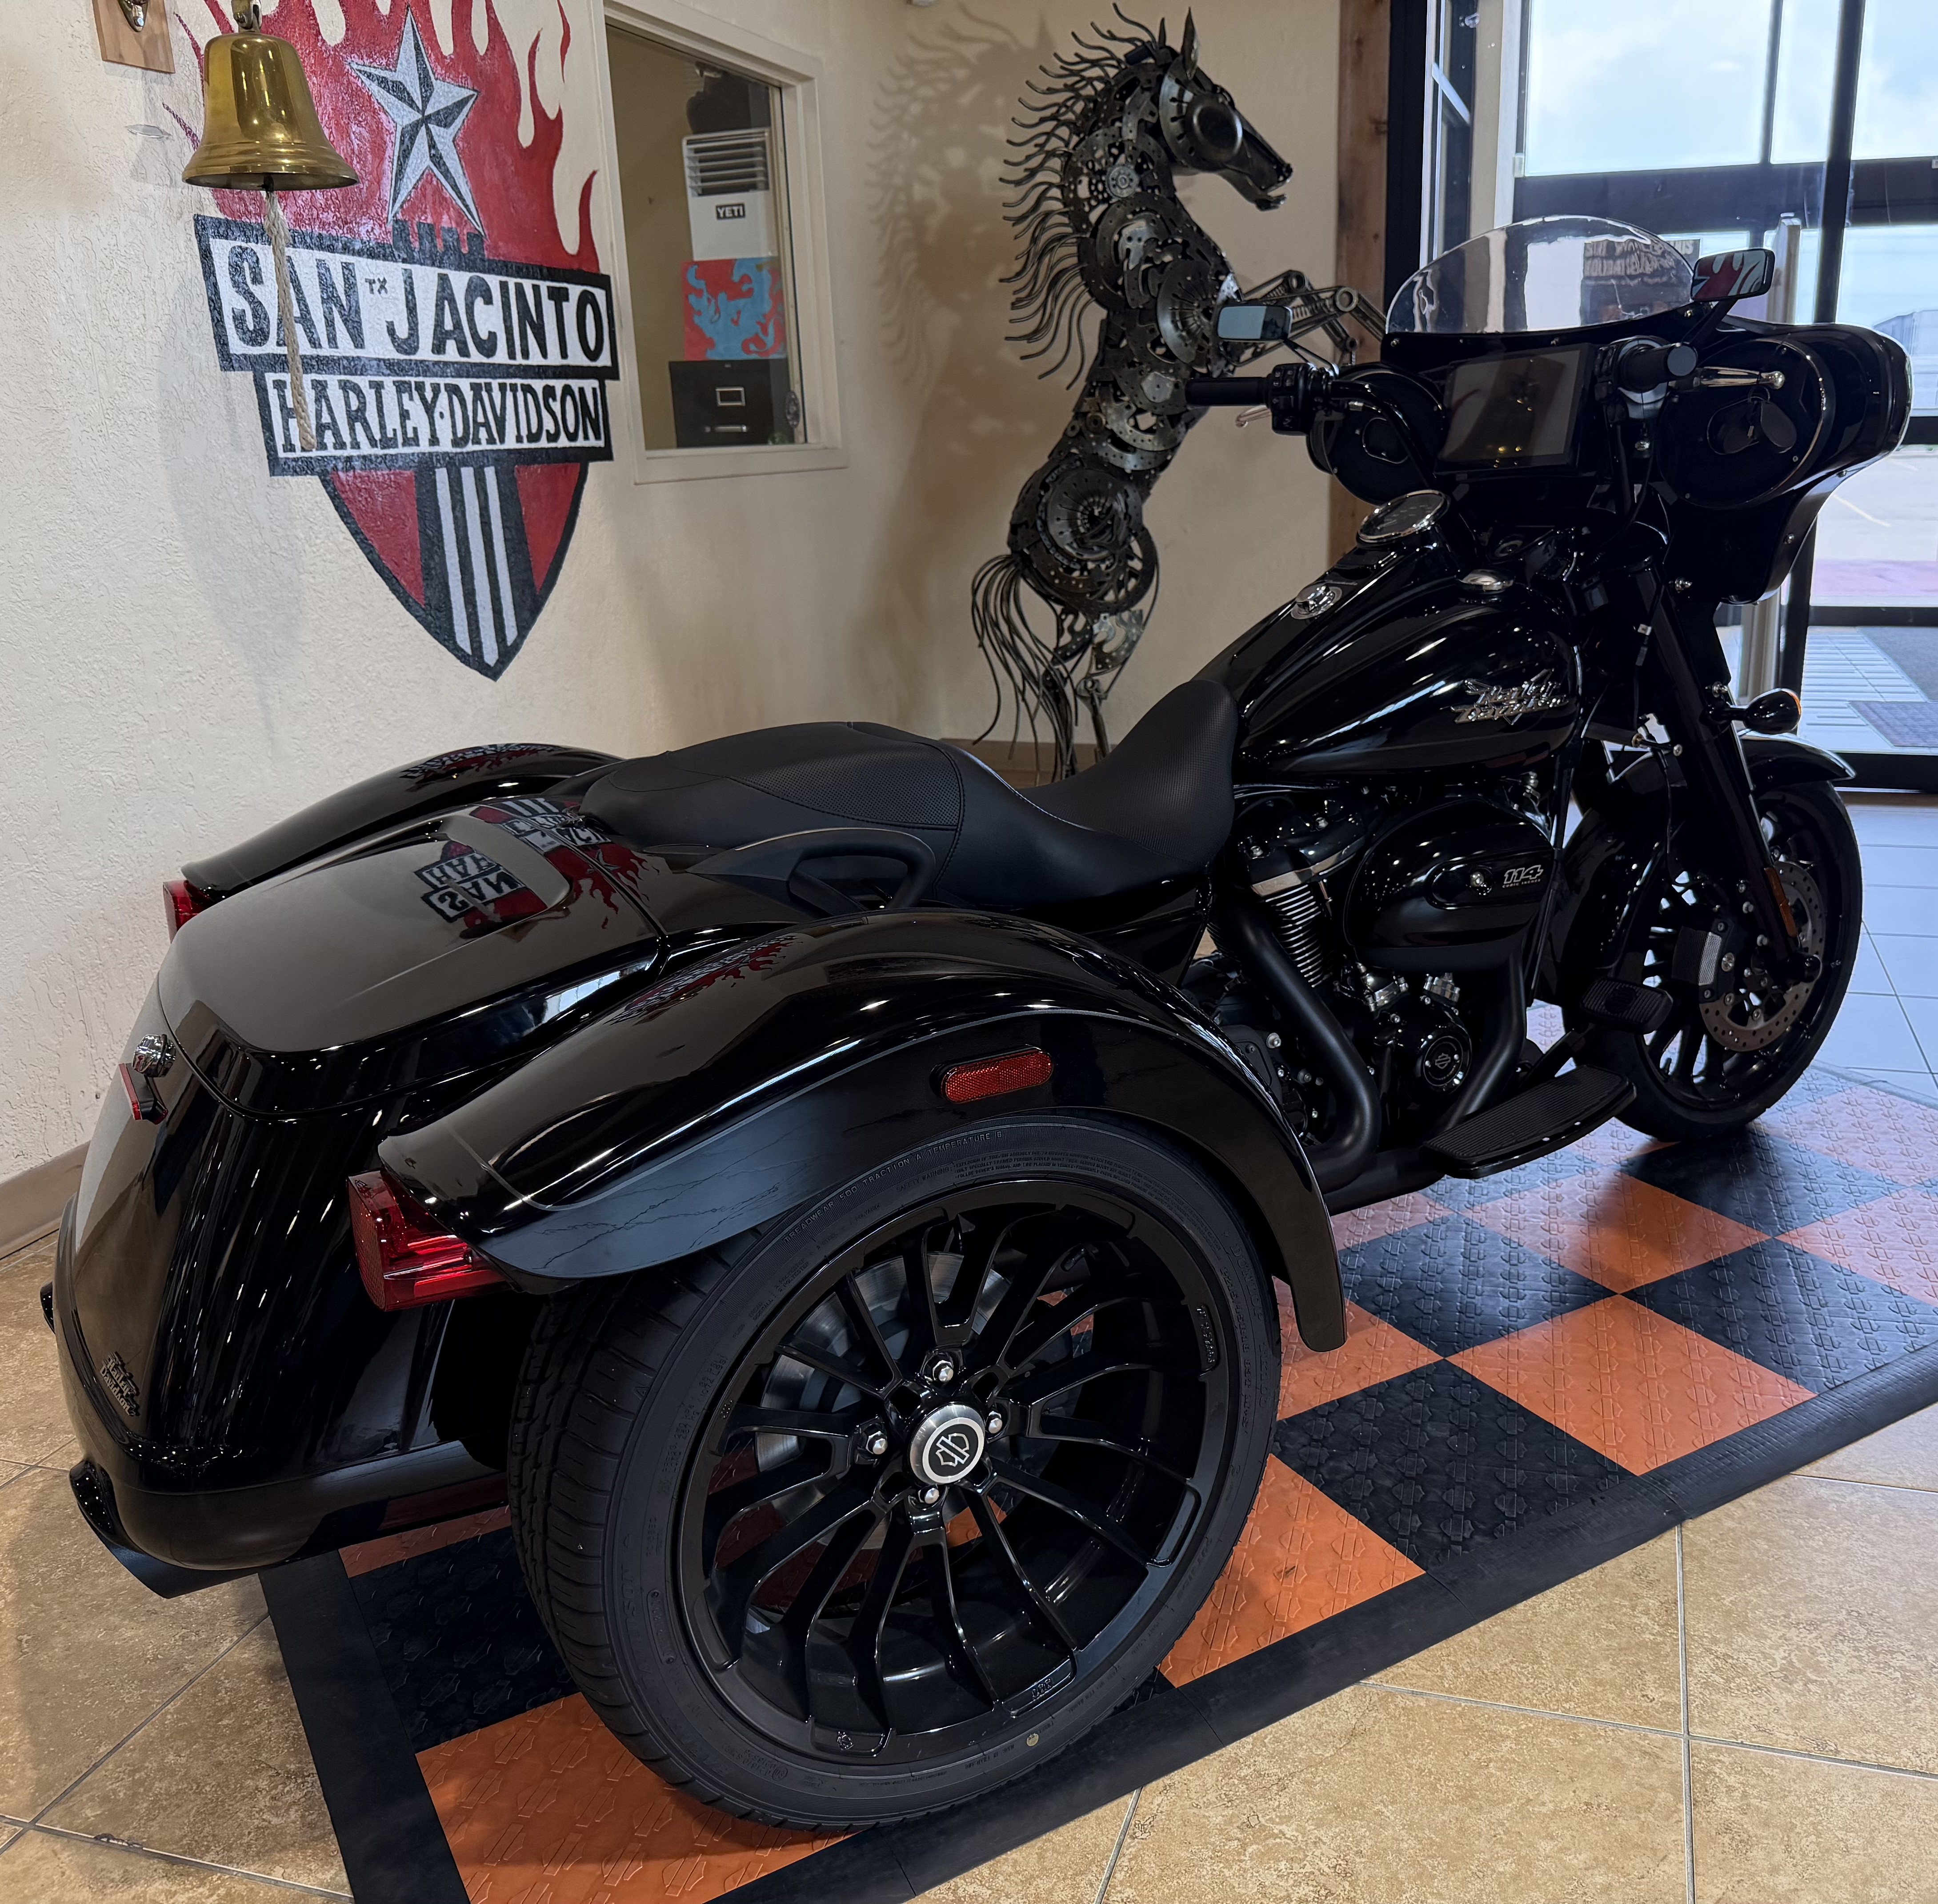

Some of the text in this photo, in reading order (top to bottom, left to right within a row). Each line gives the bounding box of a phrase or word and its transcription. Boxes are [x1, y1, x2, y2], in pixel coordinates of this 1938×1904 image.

[717, 205, 743, 218] YETI
[227, 245, 604, 362] SAN TX JACINTO
[1504, 864, 1544, 884] 114
[784, 1201, 834, 1243] TREADWEAR
[839, 1186, 857, 1200] 500
[862, 1158, 910, 1186] TRACTION
[927, 1133, 990, 1154] TEMPERATURE
[896, 1178, 920, 1192] SAFETY
[1229, 1244, 1263, 1321] DUNLOP
[100, 1365, 130, 1416] Davidson
